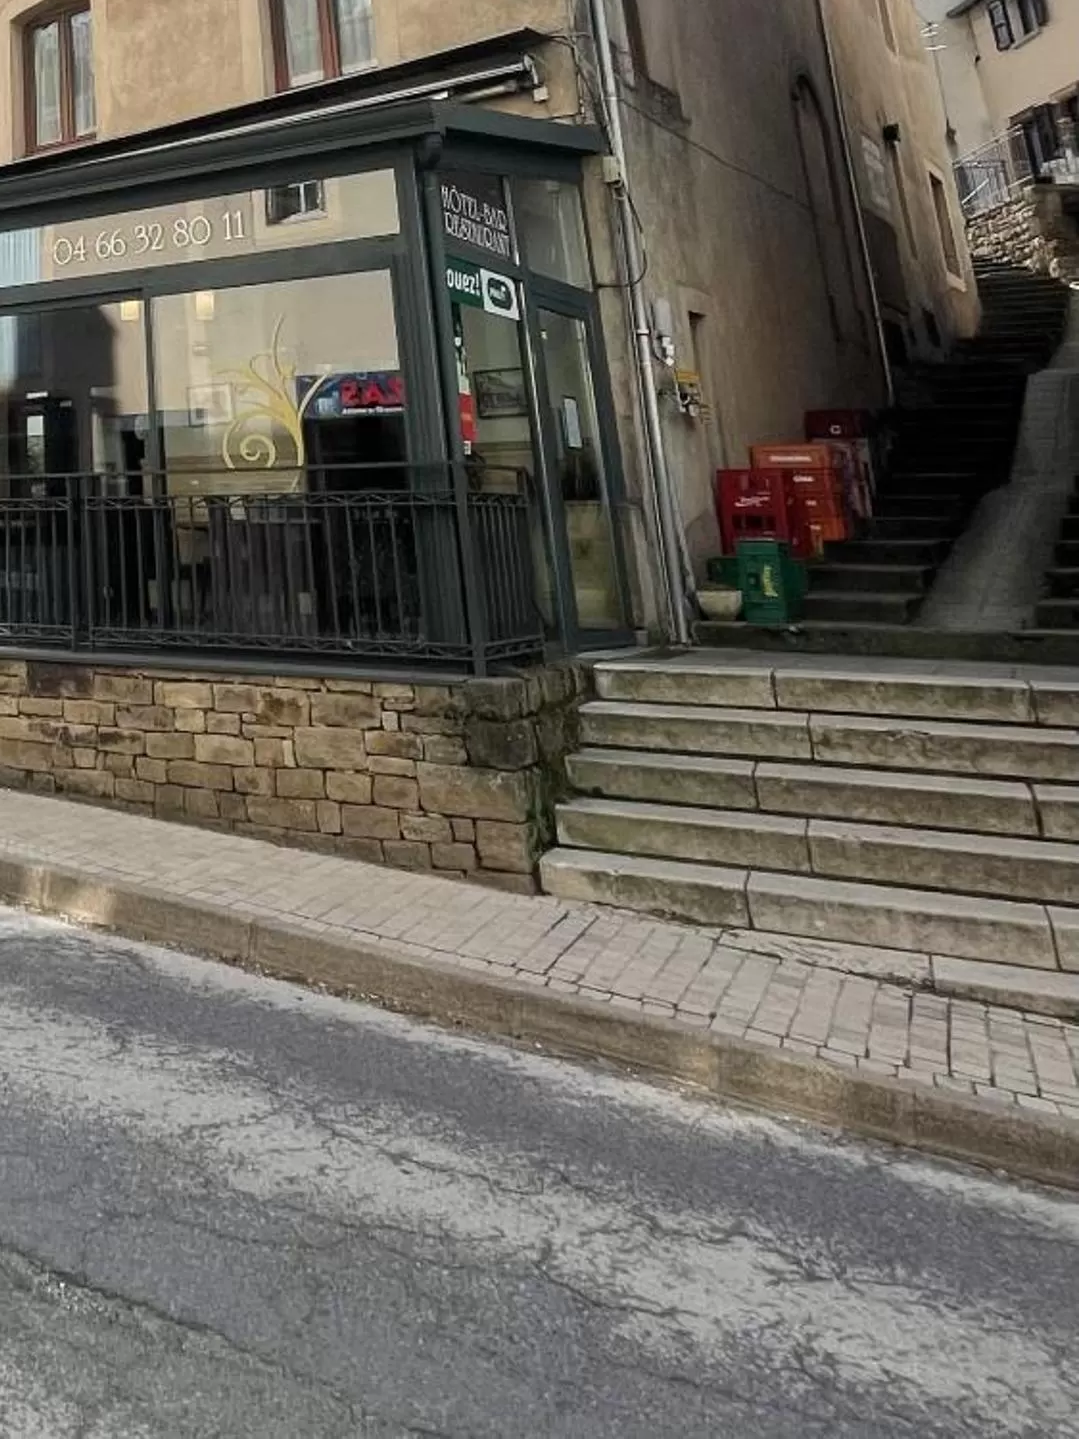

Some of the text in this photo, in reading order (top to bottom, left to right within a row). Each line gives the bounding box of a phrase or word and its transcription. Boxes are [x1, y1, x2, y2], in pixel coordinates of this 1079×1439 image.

[52, 210, 247, 266] 04 66 32 80 11
[446, 268, 481, 297] ouez!
